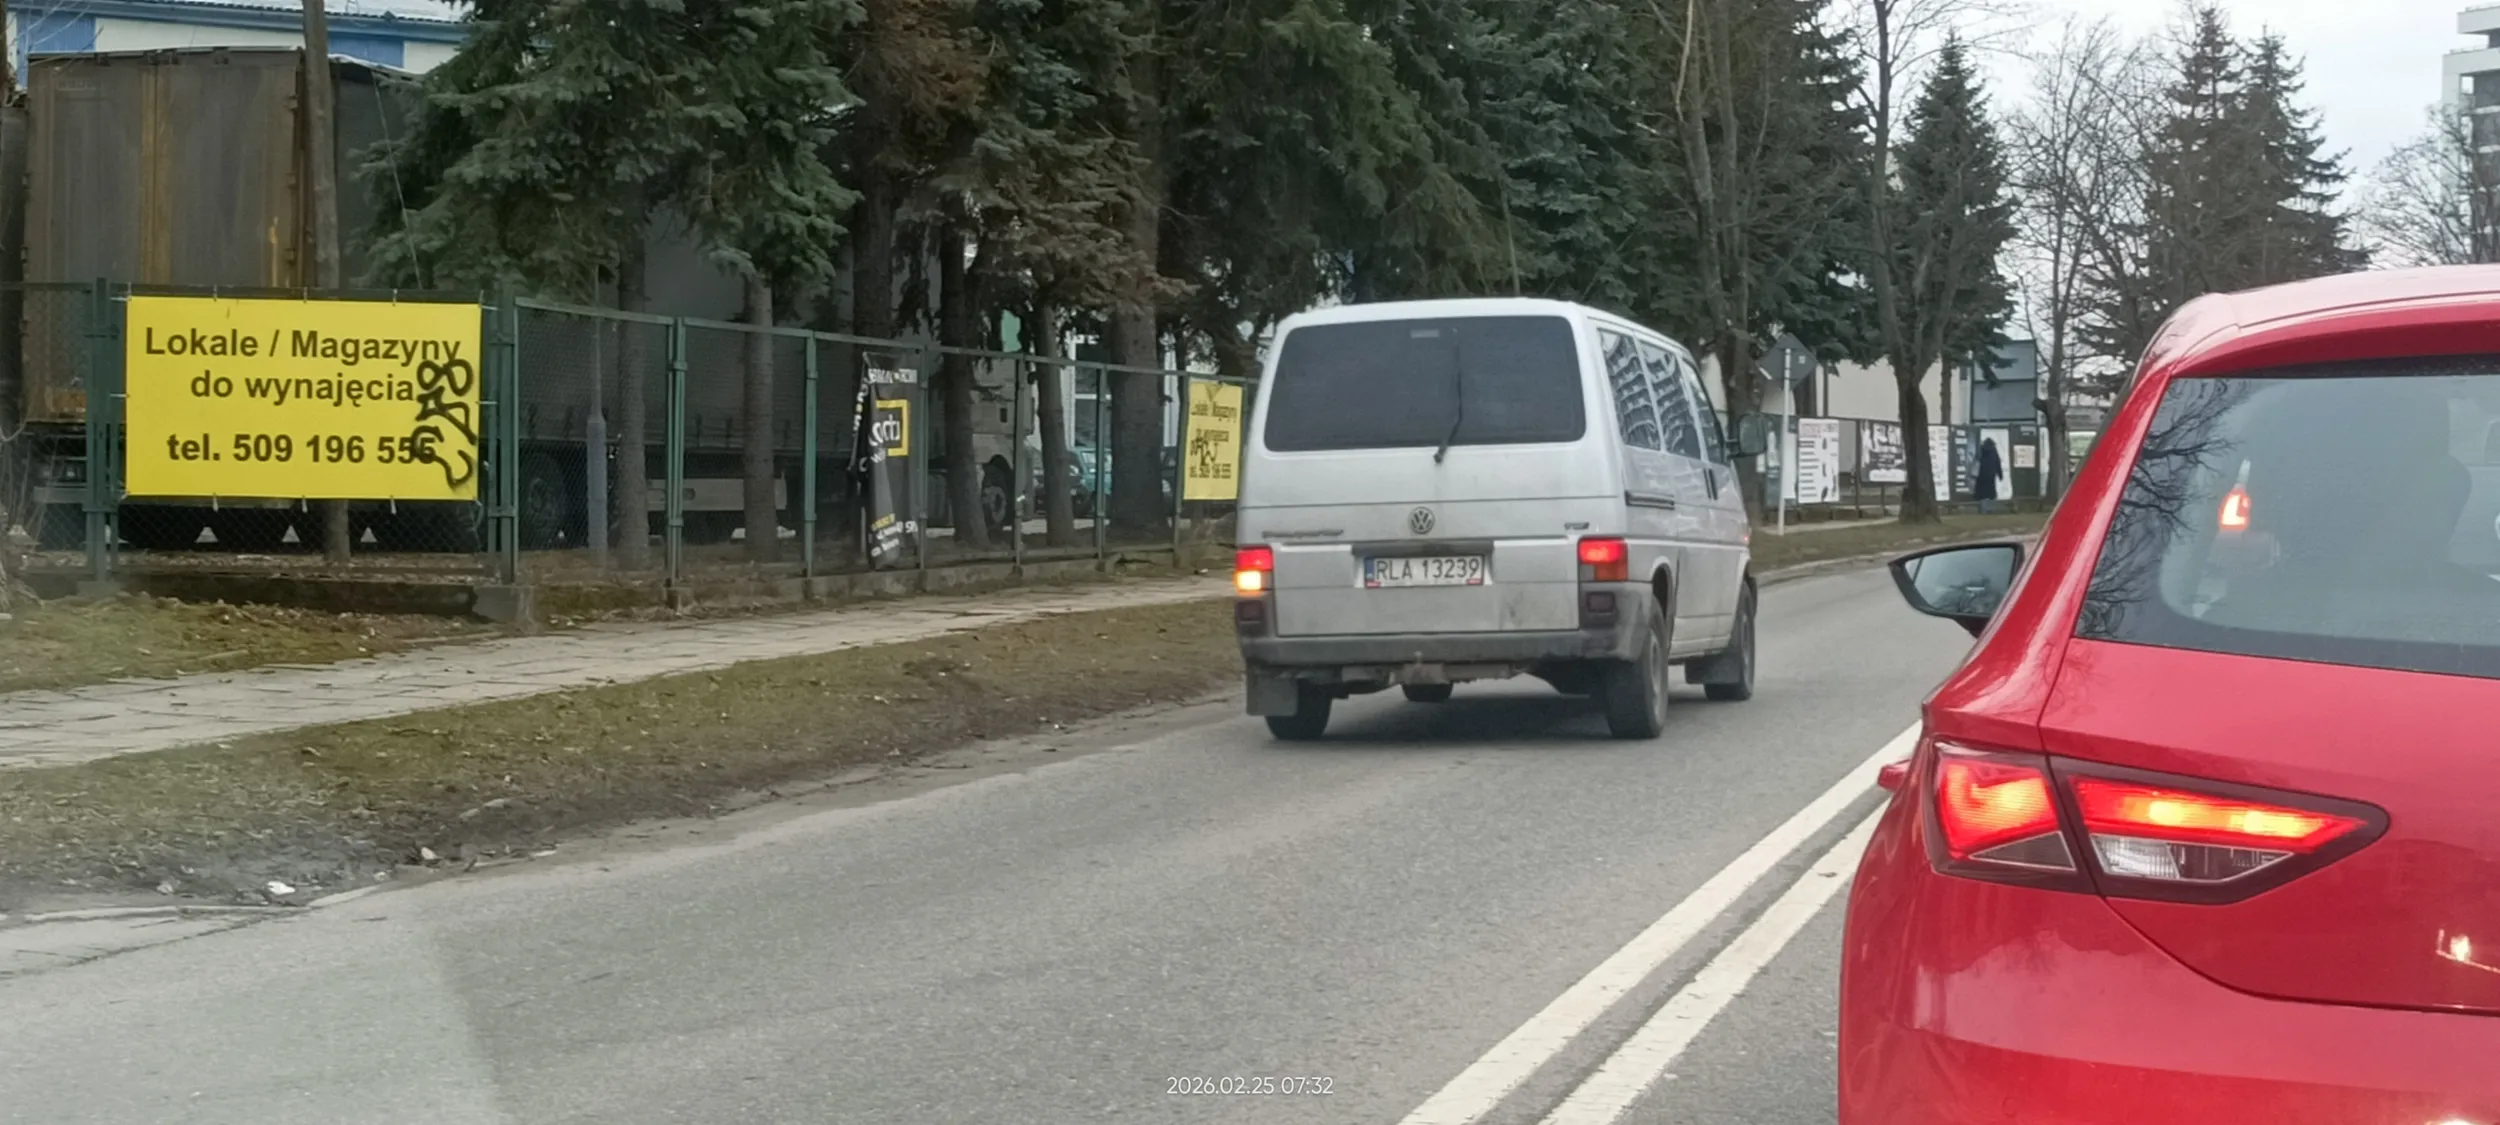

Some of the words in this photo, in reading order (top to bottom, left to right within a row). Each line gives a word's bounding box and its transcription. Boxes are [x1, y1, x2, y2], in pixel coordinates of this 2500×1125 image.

[145, 327, 259, 357] Lokale
[269, 329, 280, 358] /
[291, 330, 462, 367] Magazyny
[190, 371, 234, 398] do
[245, 372, 415, 408] wynajęcia
[167, 433, 222, 461] tel.
[233, 434, 293, 463] 509
[306, 435, 365, 464] 196
[1376, 559, 1413, 581] RLA
[1421, 558, 1481, 580] 13239
